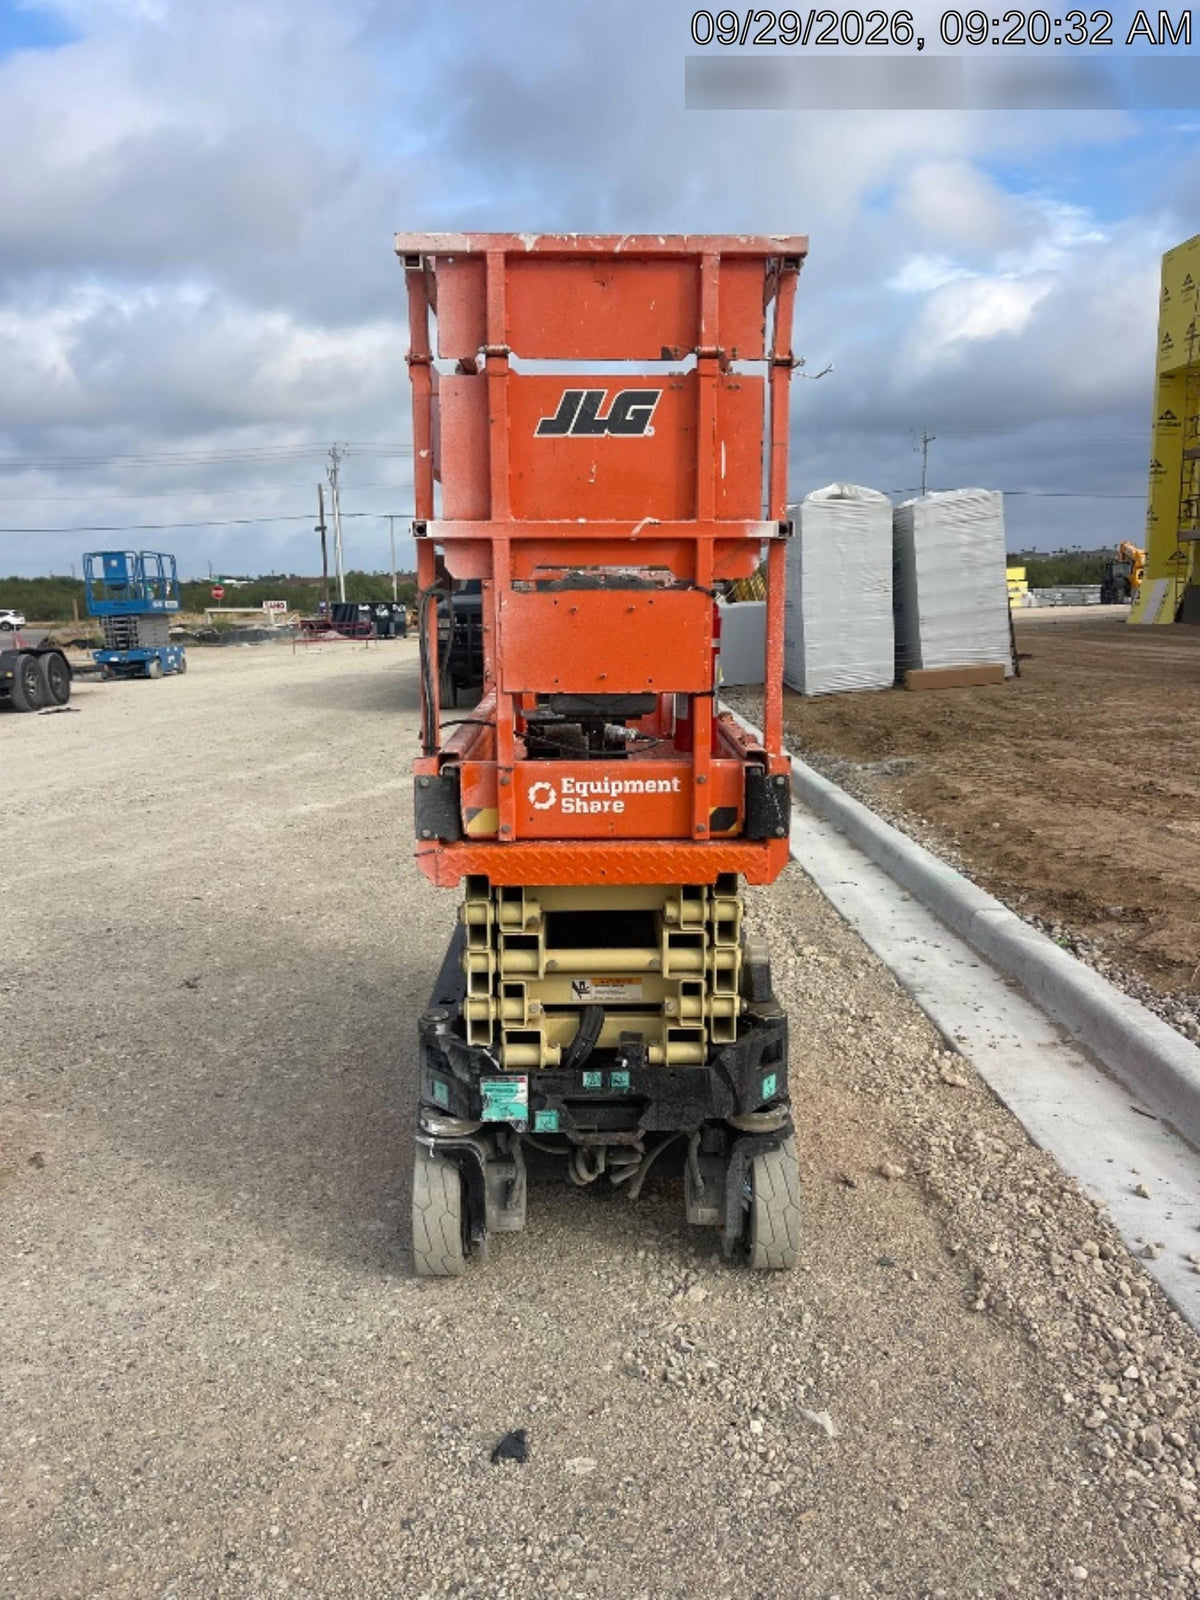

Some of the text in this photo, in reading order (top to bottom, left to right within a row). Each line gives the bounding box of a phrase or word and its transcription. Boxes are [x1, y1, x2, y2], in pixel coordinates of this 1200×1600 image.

[533, 388, 663, 438] JLG
[560, 777, 681, 796] Equipment
[560, 797, 625, 814] Share
